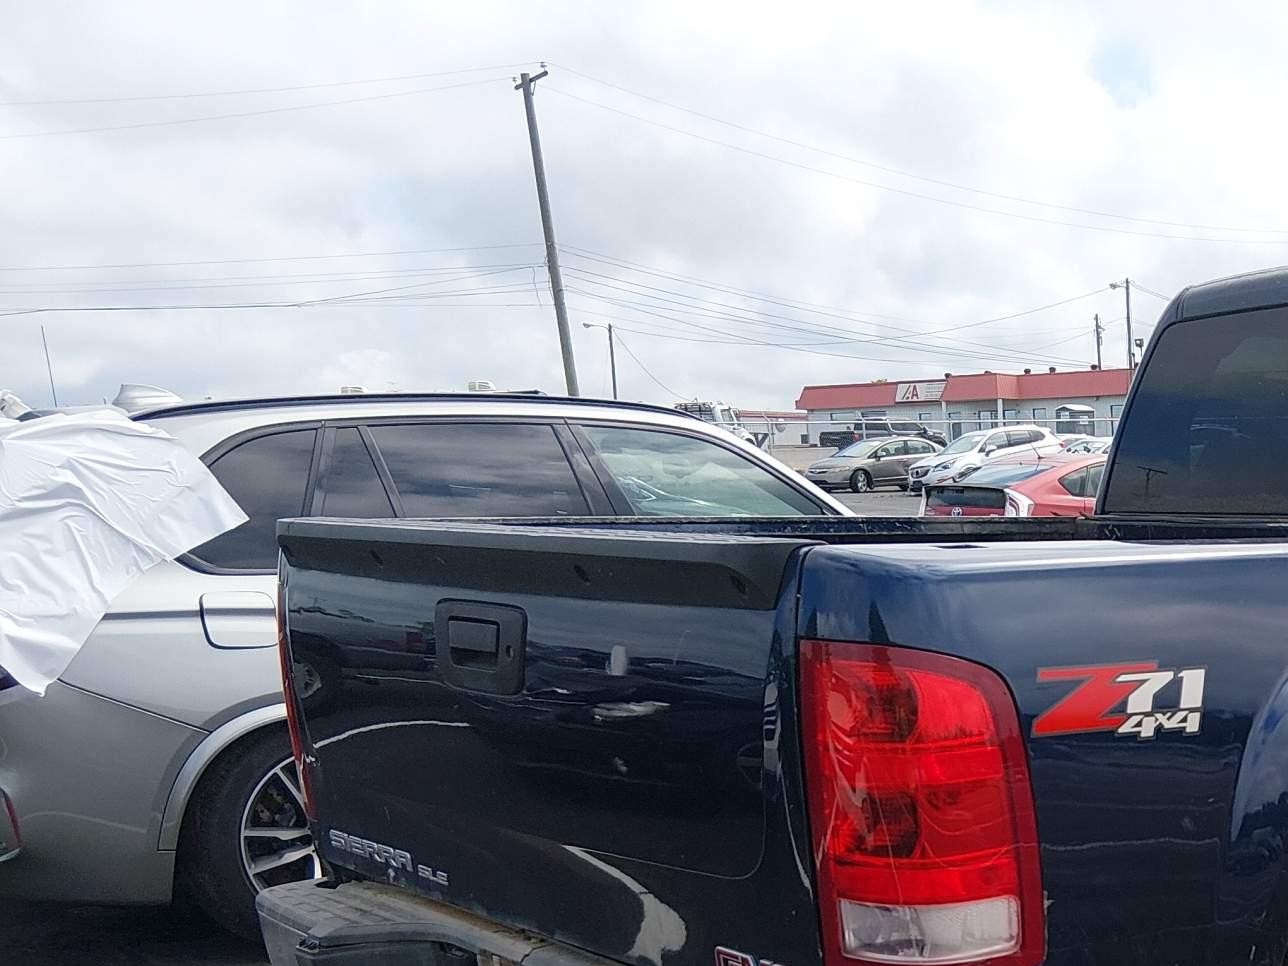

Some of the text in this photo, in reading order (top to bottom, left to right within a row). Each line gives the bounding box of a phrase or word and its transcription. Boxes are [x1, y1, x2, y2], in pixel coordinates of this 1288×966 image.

[1031, 660, 1206, 738] Z71
[329, 829, 449, 886] SIERRA SLE
